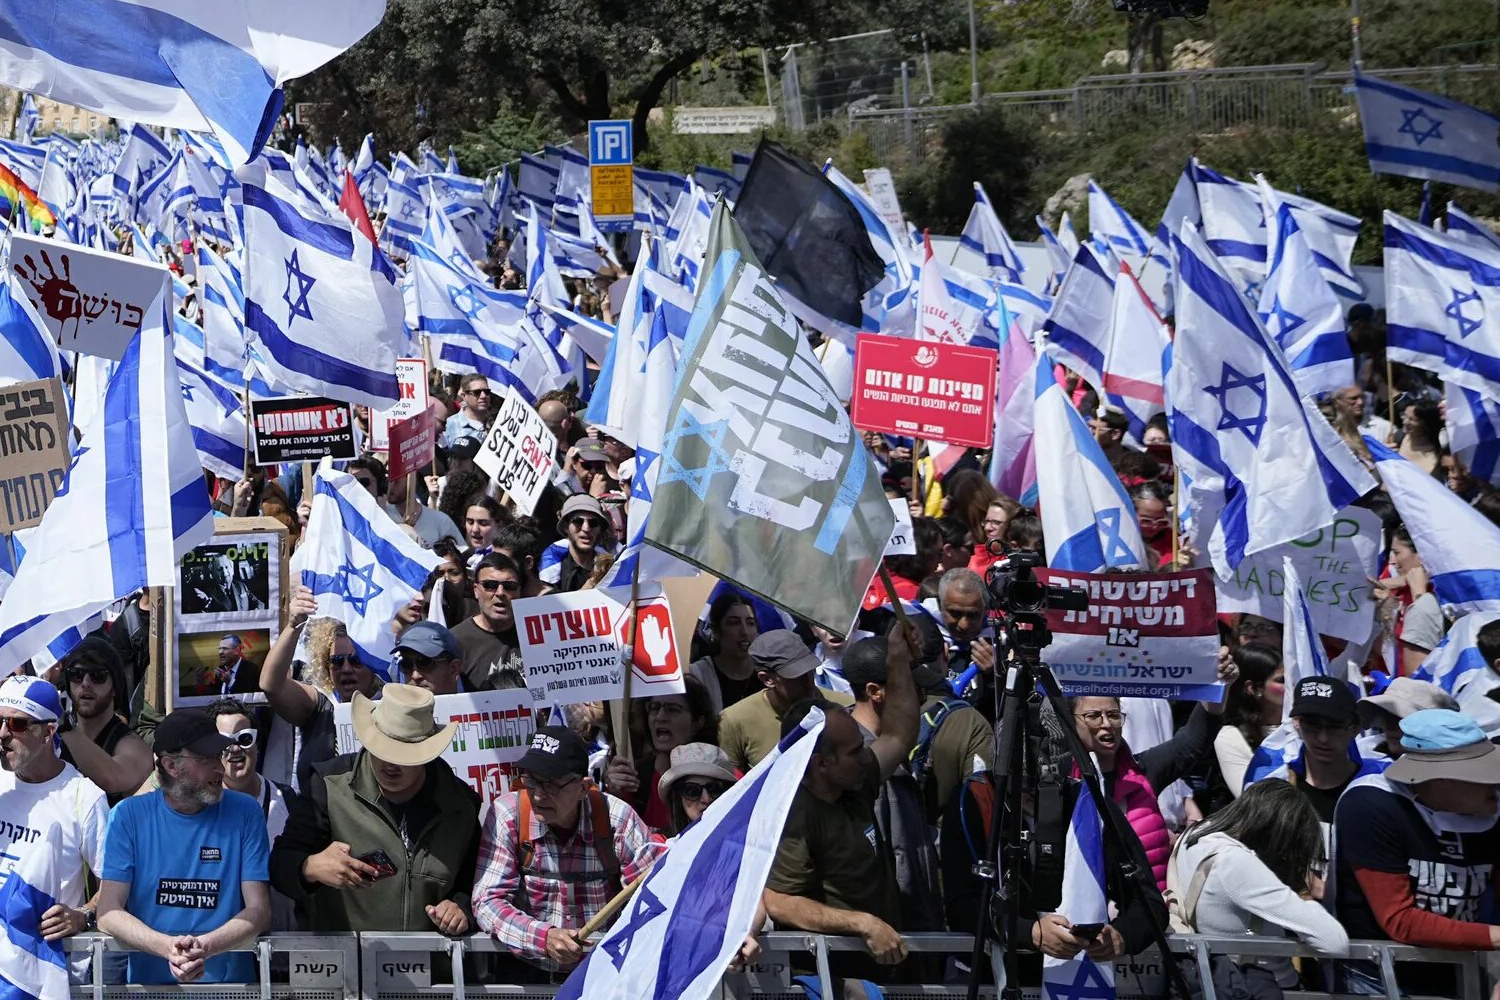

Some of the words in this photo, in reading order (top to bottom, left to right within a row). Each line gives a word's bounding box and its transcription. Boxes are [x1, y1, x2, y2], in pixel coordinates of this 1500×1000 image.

[865, 368, 903, 389] אדום
[906, 374, 924, 394] קו
[948, 401, 961, 412] לא
[325, 407, 348, 428] לא
[488, 429, 515, 463] SIT
[511, 450, 539, 496] WITH
[498, 465, 515, 491] US
[1314, 555, 1350, 574] THE
[1233, 567, 1368, 613] ADESS
[524, 606, 612, 645] עוצרים
[1108, 627, 1140, 646] או
[553, 644, 597, 658] החקיקה
[600, 642, 615, 653] את
[529, 661, 582, 676] דמוקרטית
[586, 657, 616, 668] האנטי
[161, 880, 203, 890] דמוקרטיה
[205, 880, 219, 891] אין
[159, 892, 194, 906] הייטק
[197, 894, 215, 907] אין
[295, 962, 339, 977] קשת
